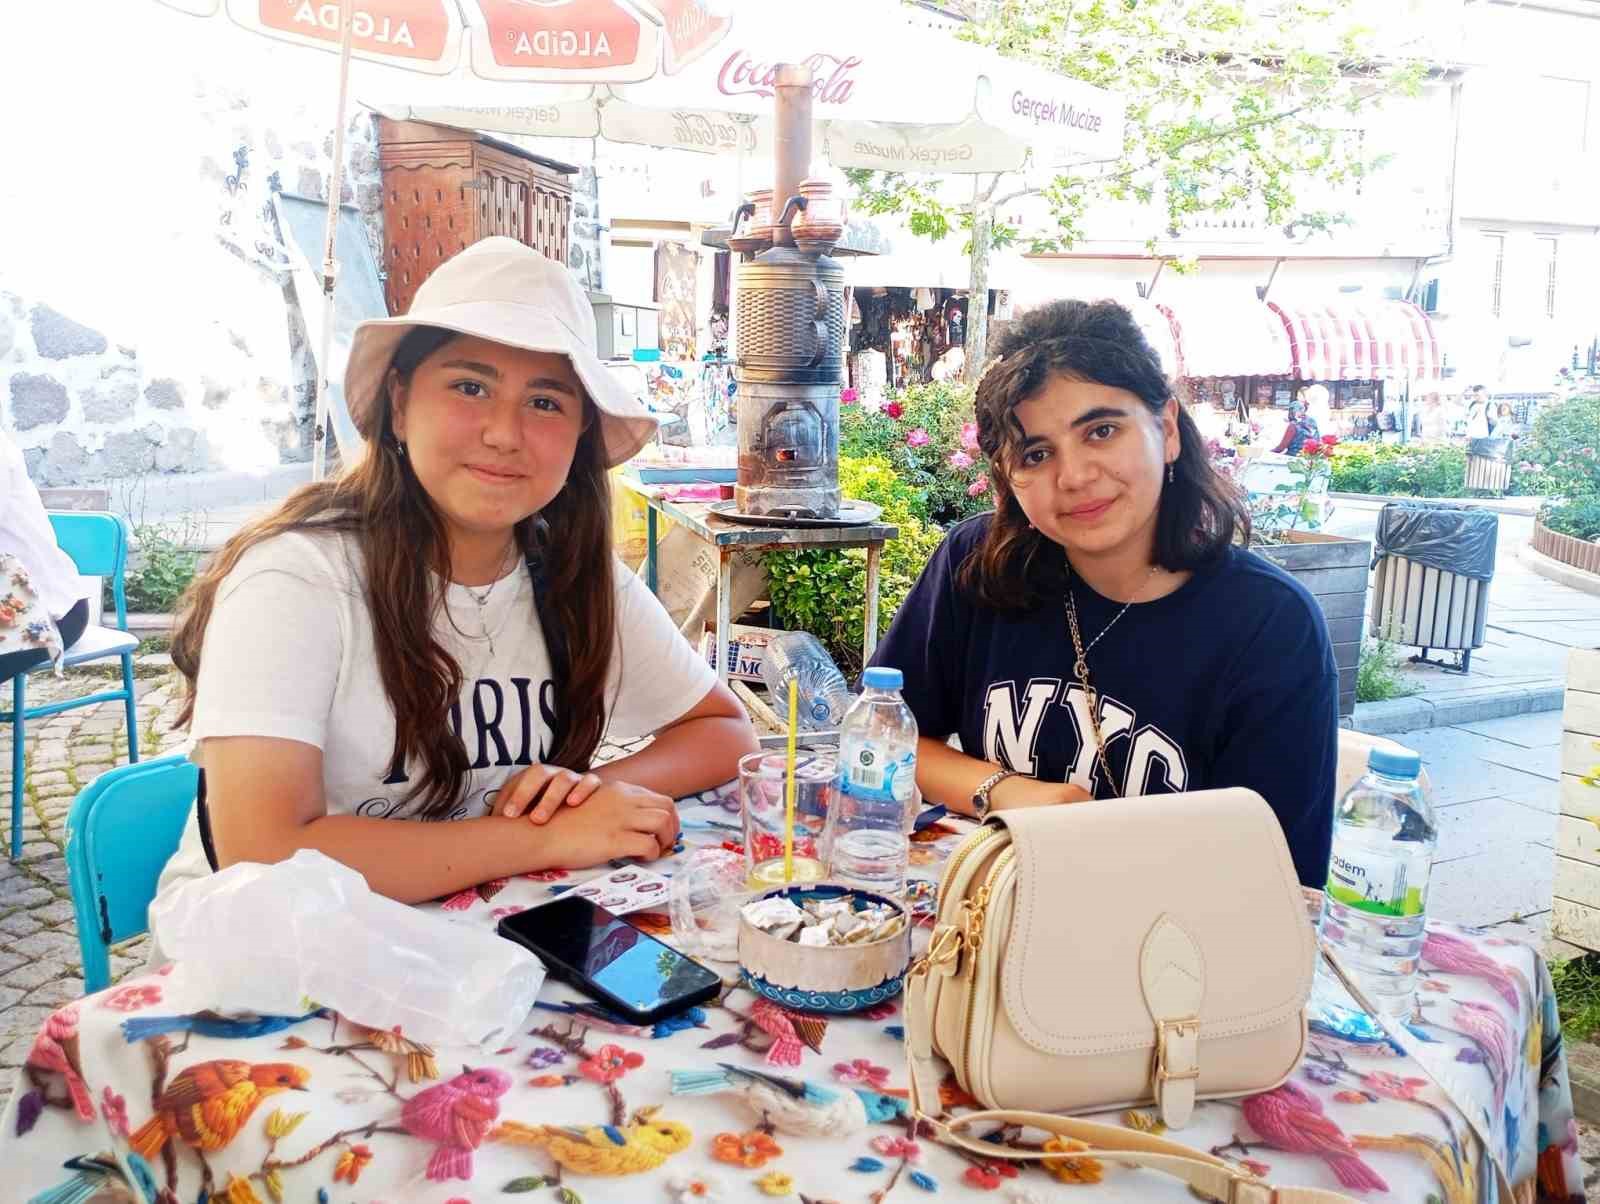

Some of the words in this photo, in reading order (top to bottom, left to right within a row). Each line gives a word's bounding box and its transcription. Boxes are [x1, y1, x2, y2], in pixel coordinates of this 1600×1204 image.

[1011, 89, 1058, 126] Gerçek
[1058, 102, 1103, 133] Mucize
[382, 677, 558, 784] RIS
[984, 677, 1189, 800] NYC
